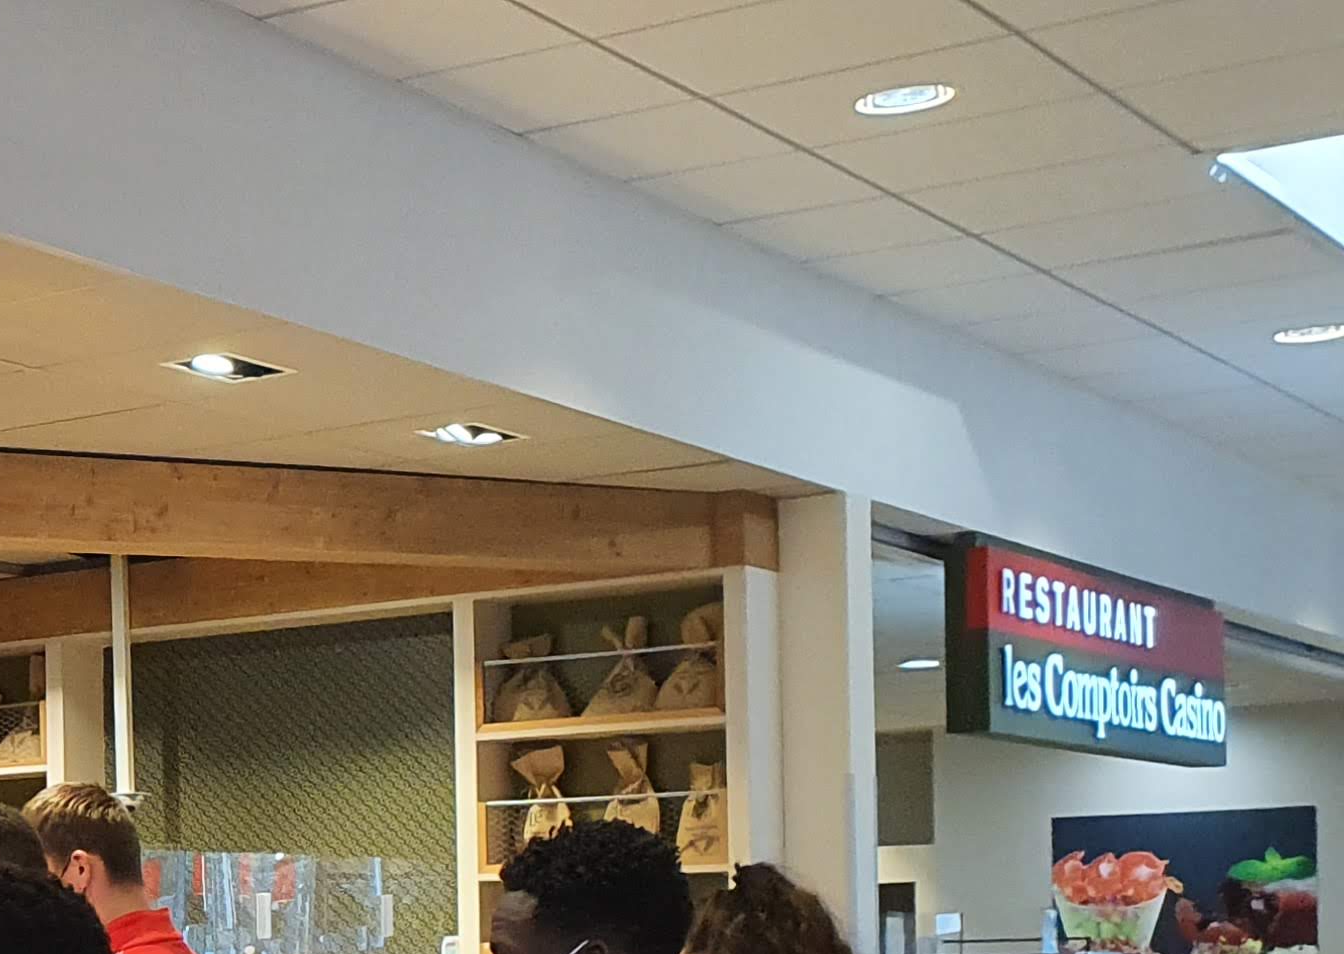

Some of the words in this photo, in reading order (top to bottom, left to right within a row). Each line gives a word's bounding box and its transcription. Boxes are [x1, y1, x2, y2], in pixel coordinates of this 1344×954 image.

[1002, 567, 1156, 649] RESTAURANT
[1001, 644, 1042, 712] les
[1045, 653, 1158, 739] Comptoirs
[1161, 679, 1226, 743] Casino
